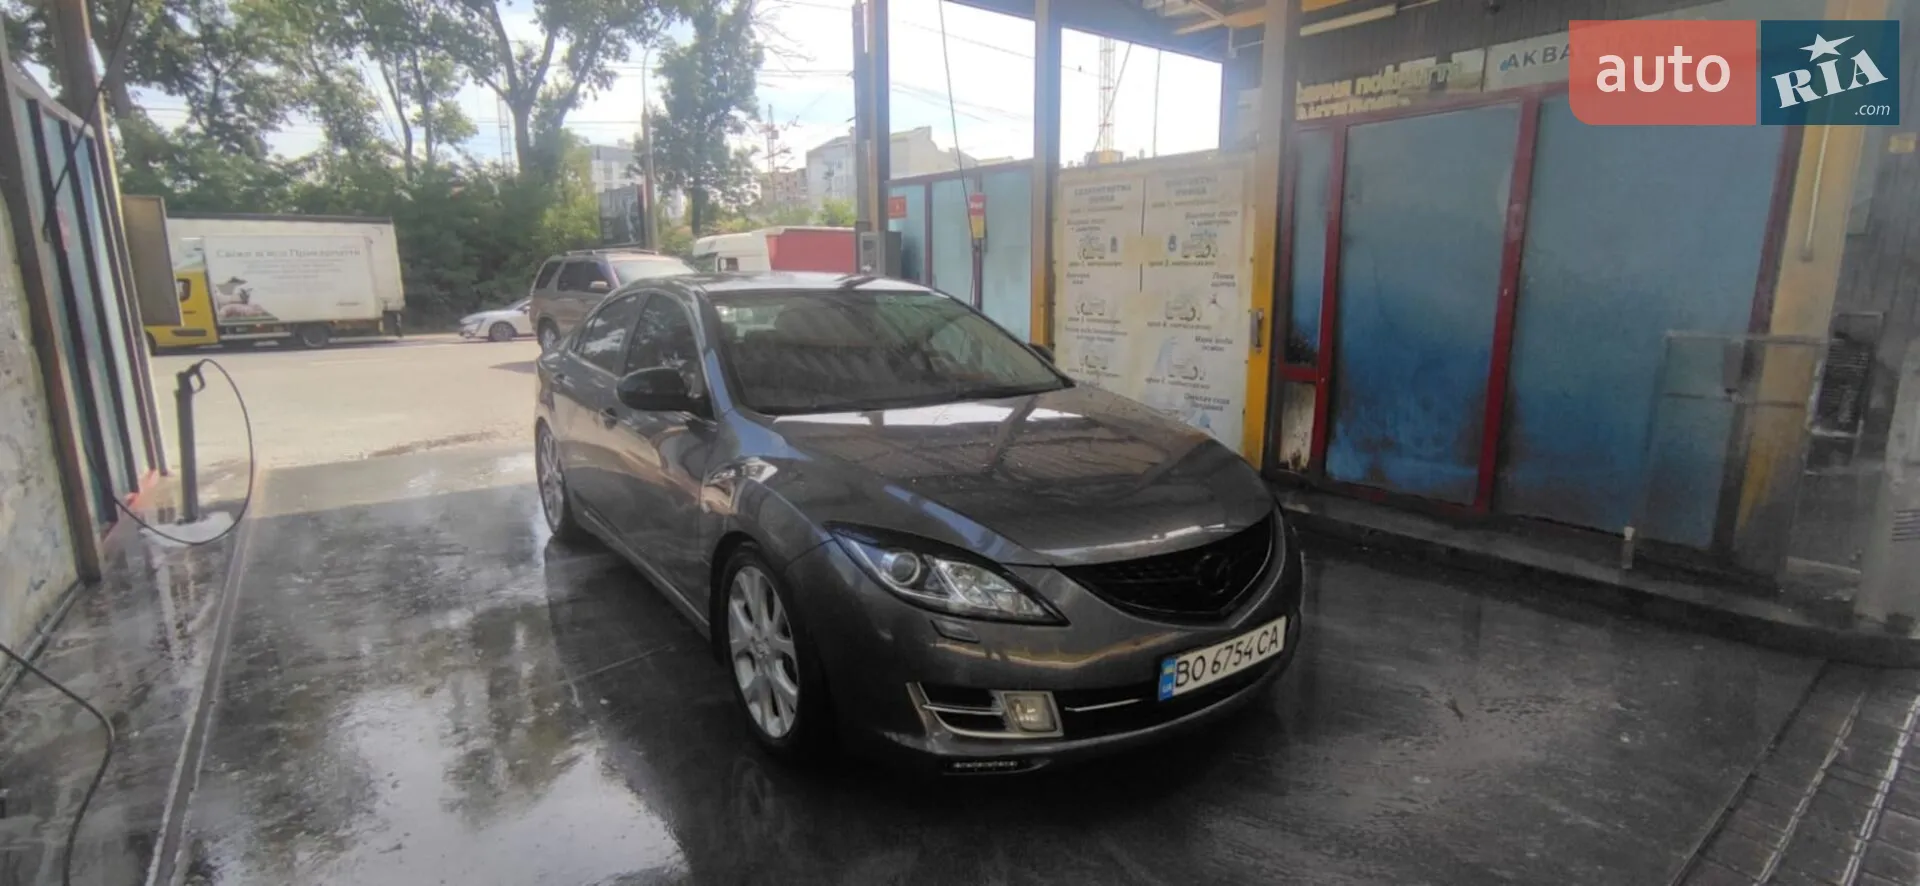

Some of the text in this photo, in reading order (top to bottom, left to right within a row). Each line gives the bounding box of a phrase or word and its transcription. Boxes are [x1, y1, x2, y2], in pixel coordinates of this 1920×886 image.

[1175, 625, 1279, 688] BO 6754 CA
